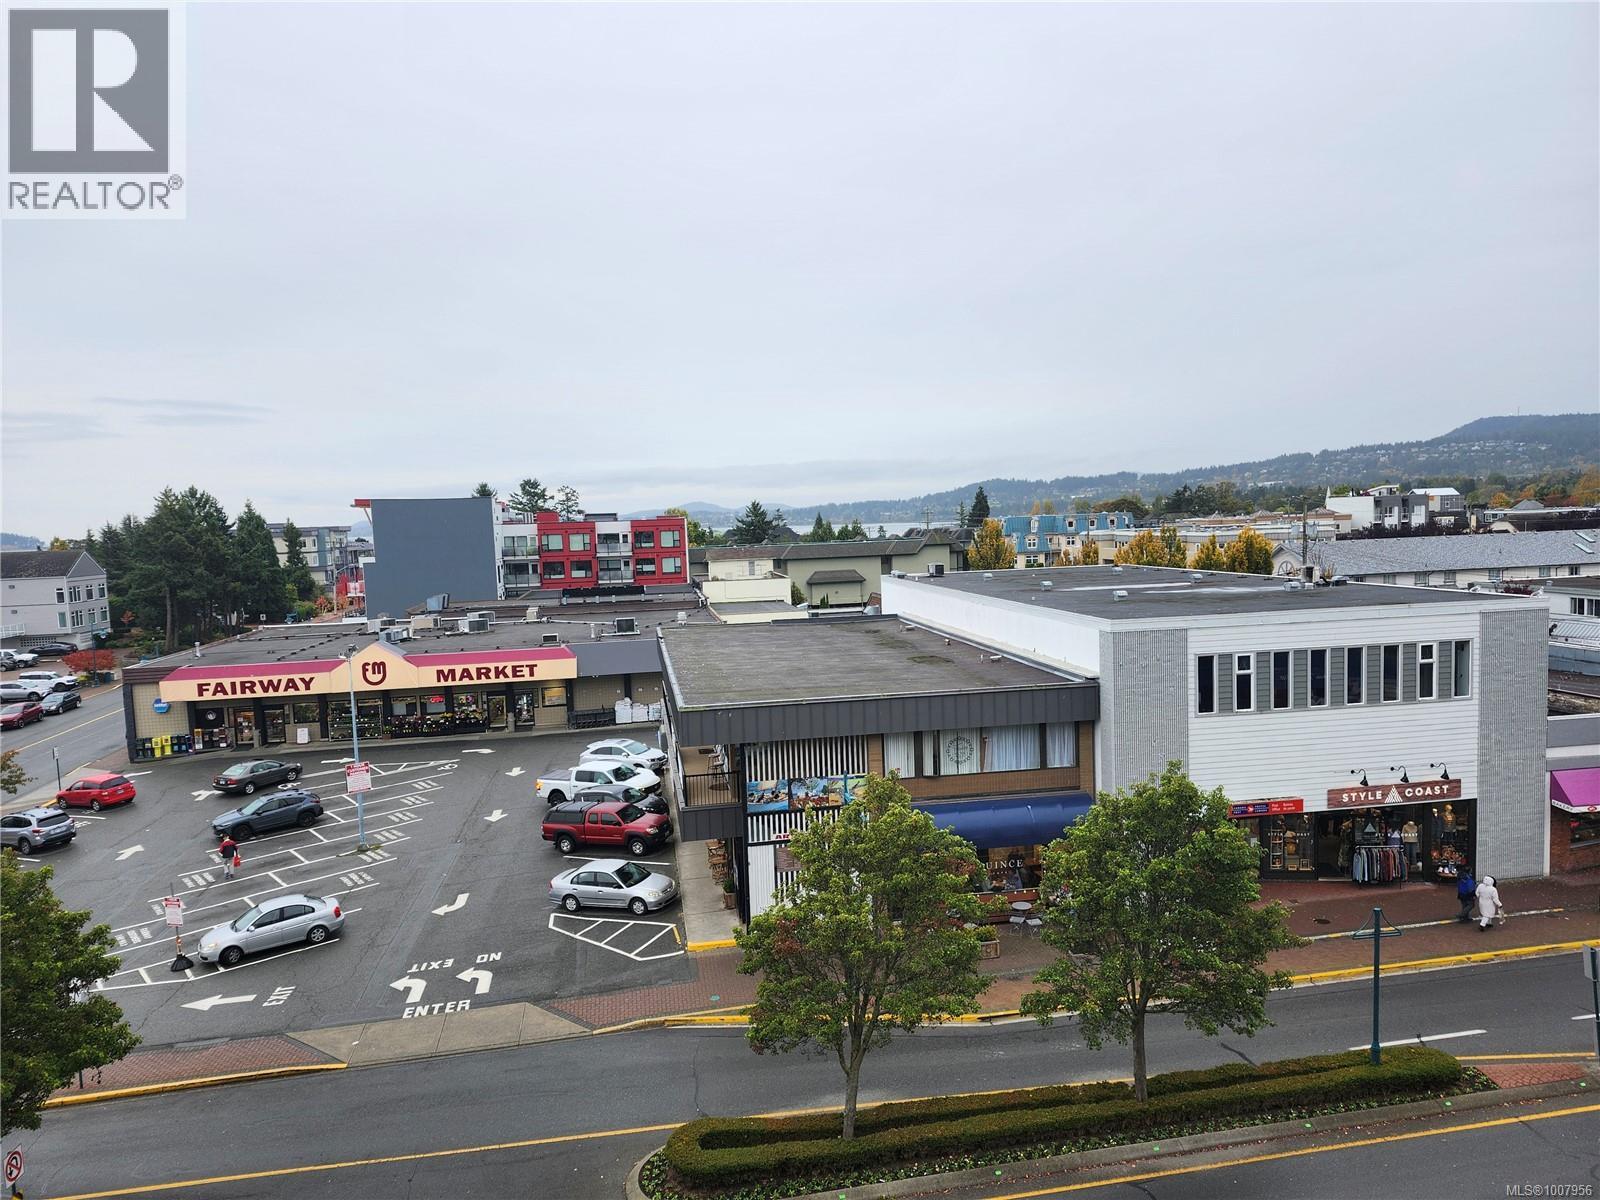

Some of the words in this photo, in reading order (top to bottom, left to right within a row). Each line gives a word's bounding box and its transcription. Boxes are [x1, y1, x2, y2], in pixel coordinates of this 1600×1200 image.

[196, 677, 315, 697] FAIRWAY
[436, 664, 538, 683] MARKET
[1342, 790, 1382, 802] STYLE
[1404, 785, 1449, 797] COAST
[986, 859, 1024, 870] UINCE
[406, 958, 455, 973] EXIT
[262, 986, 297, 1007] EXIT
[402, 1000, 471, 1019] ENTER
